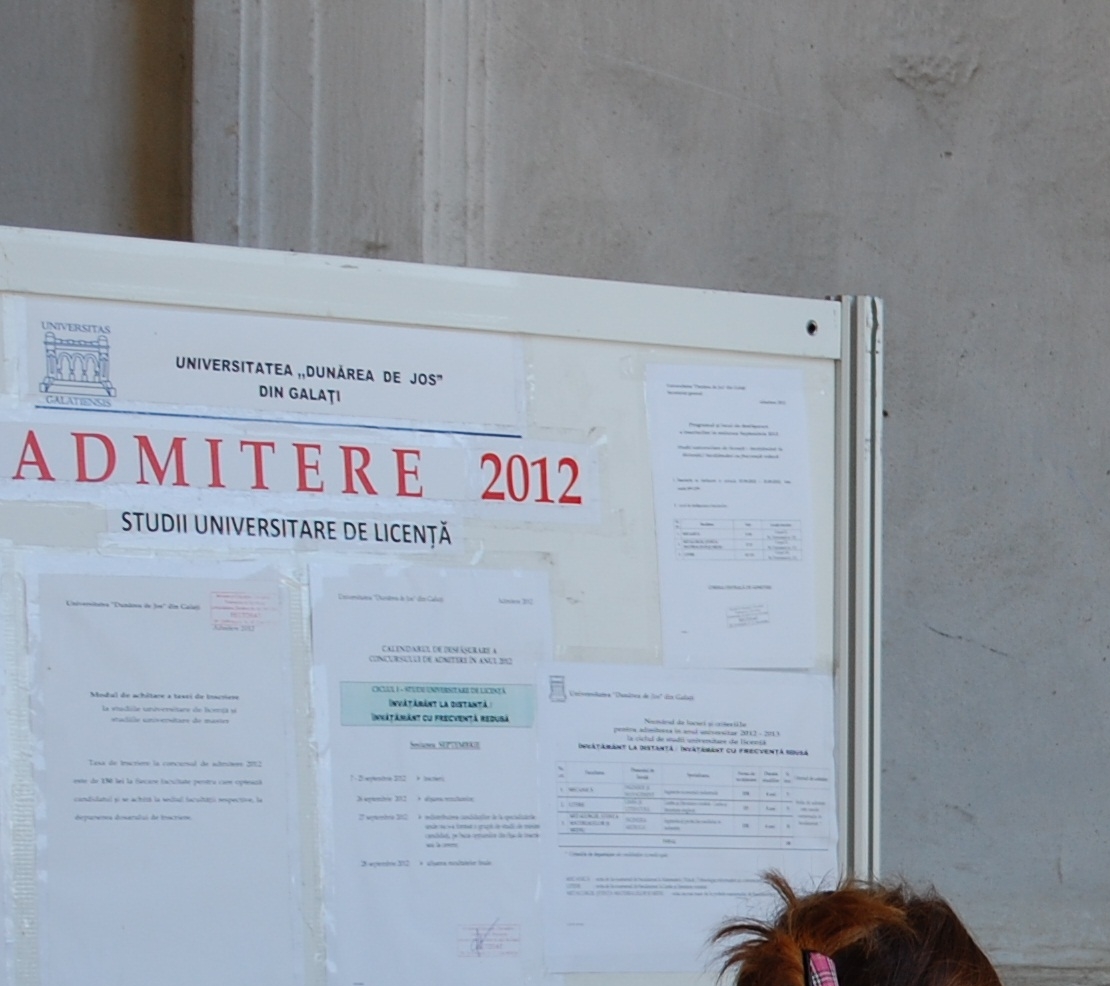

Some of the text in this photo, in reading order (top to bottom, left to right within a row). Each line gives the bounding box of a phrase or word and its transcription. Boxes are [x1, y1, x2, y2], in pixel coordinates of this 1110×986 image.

[42, 321, 112, 334] UNIVERSITAS
[175, 356, 292, 376] UNIVERSITATEA
[382, 370, 401, 384] DE
[46, 396, 112, 407] GALATIENSIS
[258, 384, 284, 398] DIN
[11, 429, 584, 505] ADMITERE 2012
[121, 511, 187, 534] STUDII
[194, 514, 336, 540] UNIVERSITARE
[343, 521, 367, 541] DE
